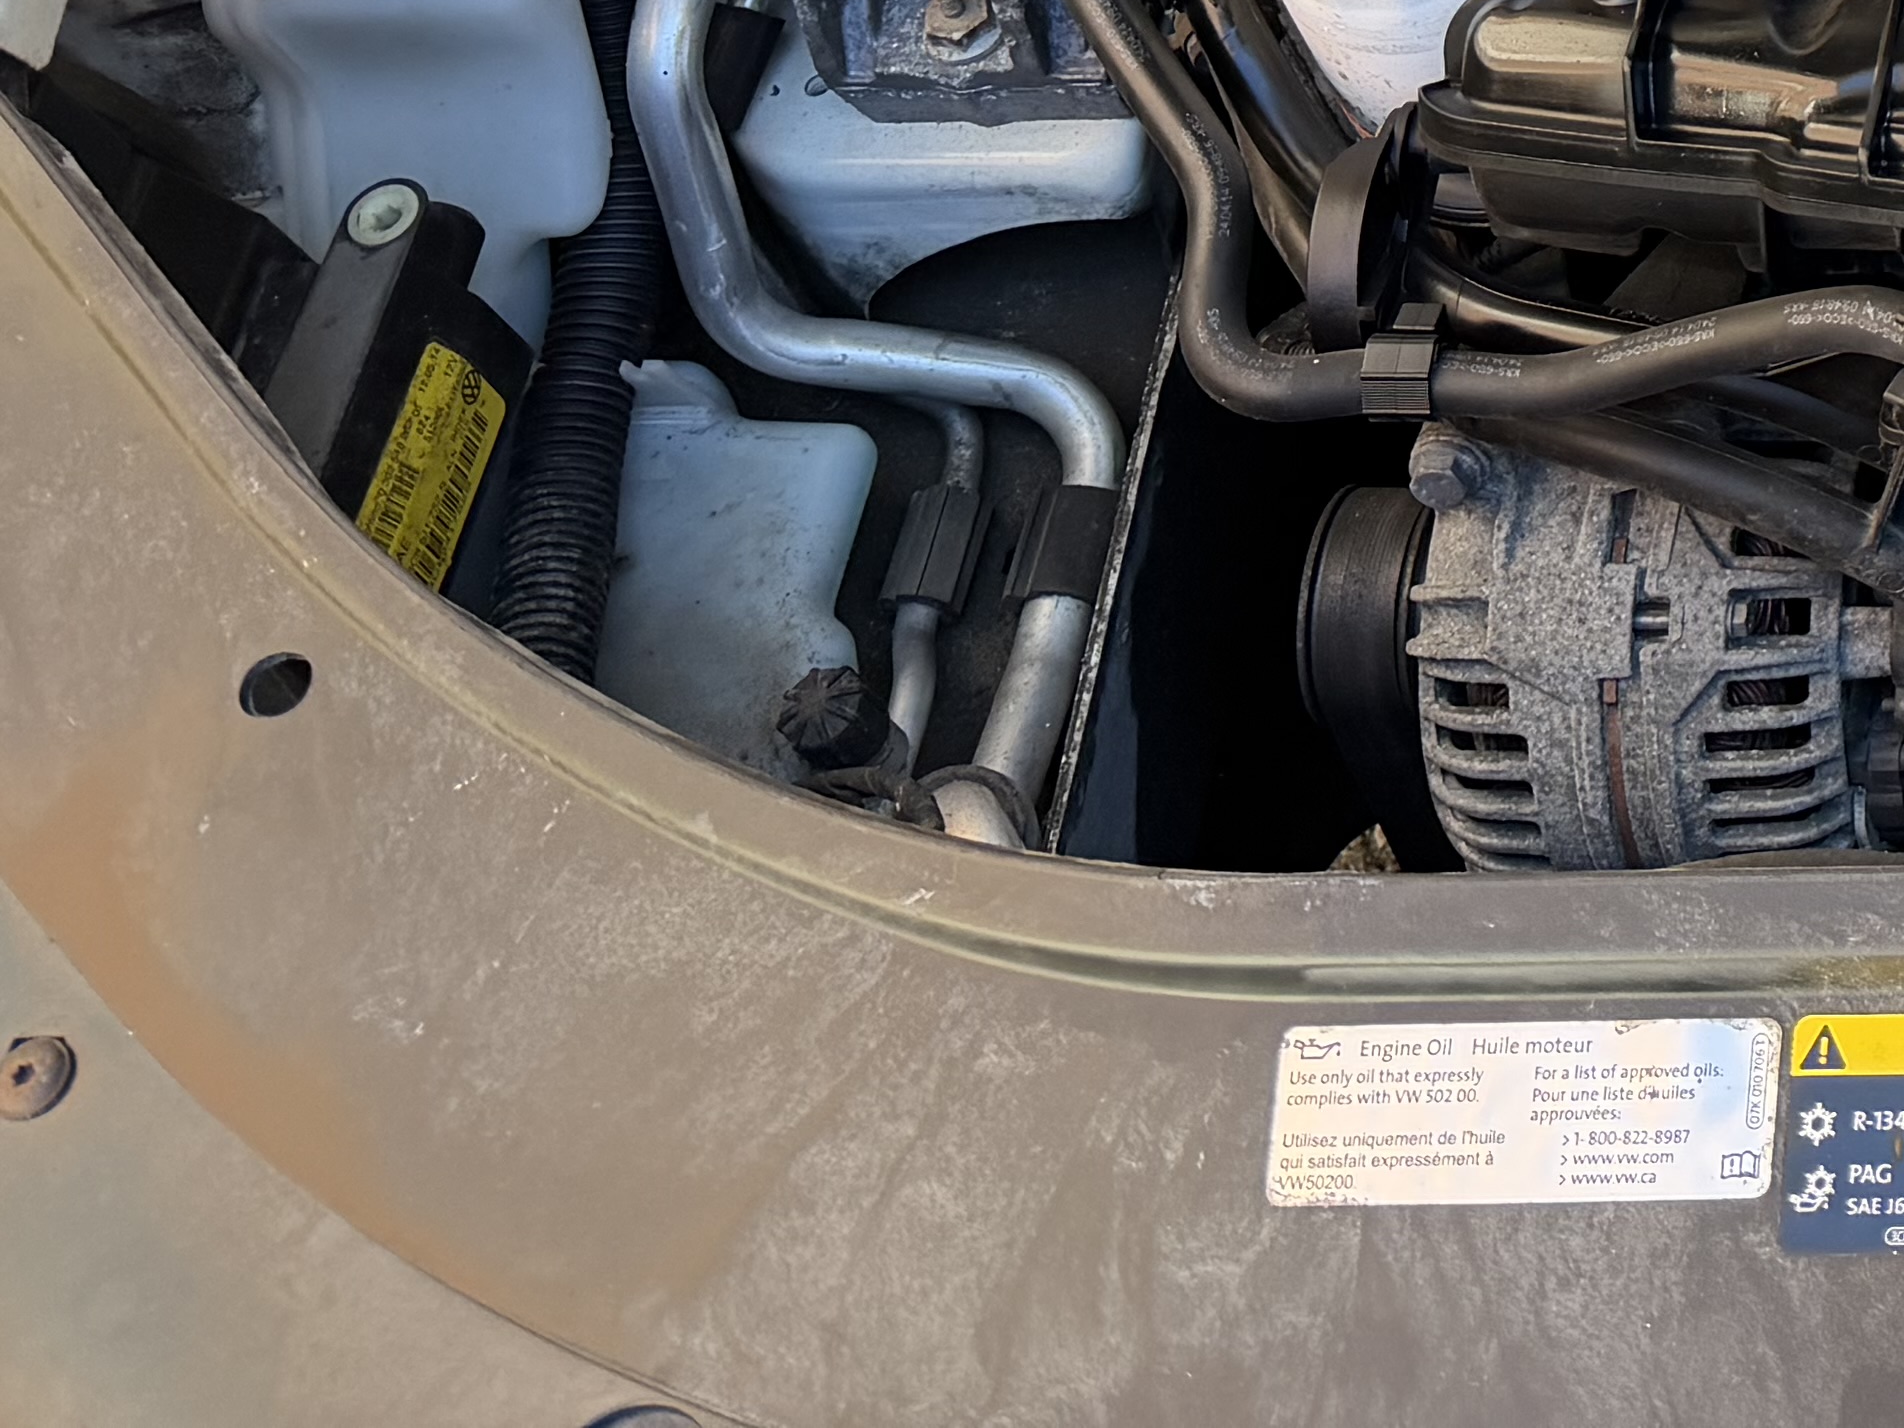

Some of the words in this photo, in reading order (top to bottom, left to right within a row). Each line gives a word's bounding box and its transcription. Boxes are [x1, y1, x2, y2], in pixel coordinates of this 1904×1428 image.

[1360, 1039, 1422, 1062] Engine
[1426, 1038, 1452, 1056] Oil
[1472, 1037, 1520, 1056] Huile
[1525, 1036, 1593, 1055] moteur
[1289, 1069, 1316, 1085] Use
[1320, 1069, 1353, 1088] only
[1356, 1068, 1375, 1084] oil
[1379, 1068, 1410, 1084] that
[1413, 1068, 1484, 1087] expressly
[1534, 1066, 1557, 1081] For
[1560, 1069, 1569, 1080] a
[1574, 1065, 1596, 1080] list
[1600, 1064, 1618, 1079] of
[1620, 1064, 1690, 1083] approved
[1693, 1063, 1724, 1078] oils:
[1286, 1089, 1352, 1108] complies
[1356, 1088, 1390, 1104] with
[1395, 1088, 1422, 1103] VW
[1425, 1088, 1452, 1103] 502
[1456, 1087, 1479, 1103] 00.
[1532, 1086, 1566, 1102] Pour
[1570, 1090, 1600, 1102] une
[1603, 1086, 1634, 1101] liste
[1530, 1105, 1623, 1123] approuvées:
[1282, 1131, 1337, 1147] Utilisez
[1342, 1130, 1433, 1150] uniquement
[1437, 1130, 1456, 1145] de
[1280, 1152, 1303, 1172] qui
[1307, 1152, 1366, 1167] satisfait
[1370, 1150, 1480, 1170] expressément
[1484, 1150, 1494, 1165] à
[1571, 1149, 1675, 1165] www.vw.com
[1571, 1170, 1657, 1186] www.vw.ca
[1849, 1164, 1892, 1184] PAG
[1846, 1197, 1880, 1215] SAE
